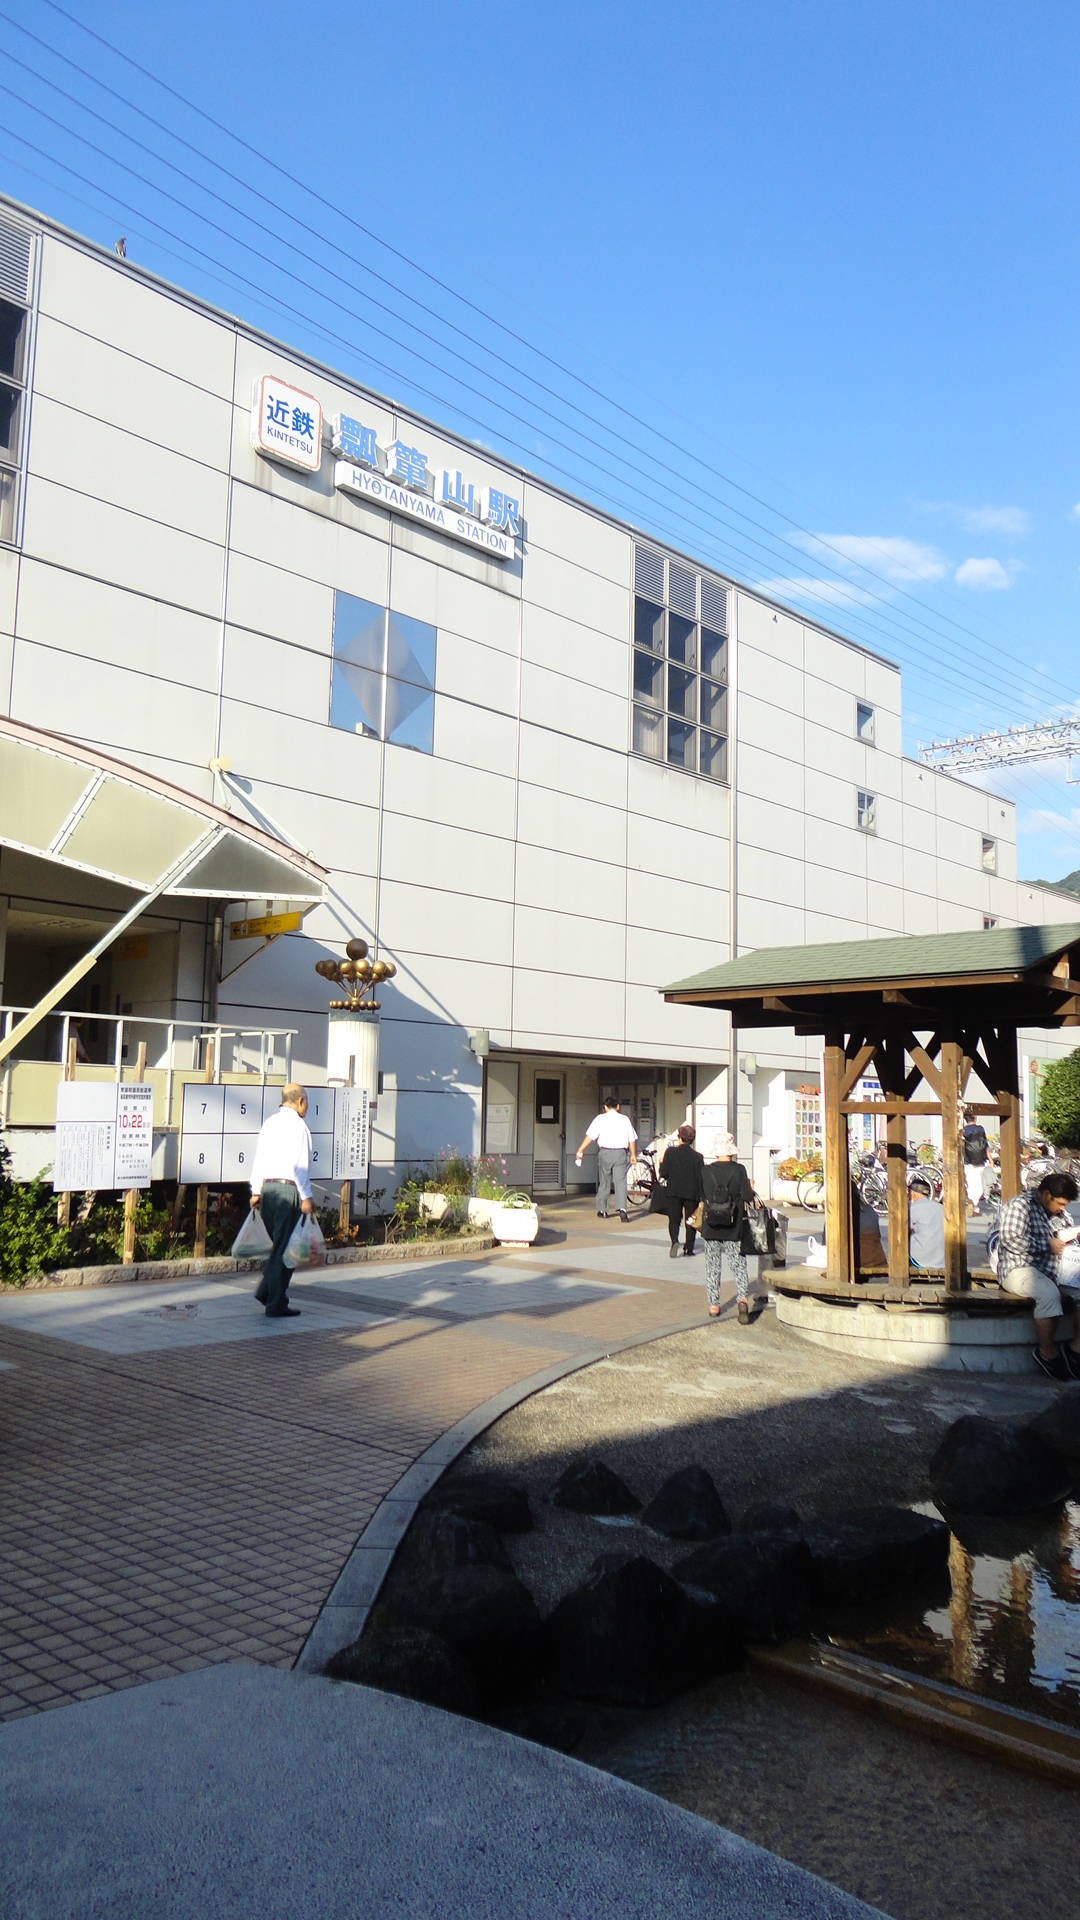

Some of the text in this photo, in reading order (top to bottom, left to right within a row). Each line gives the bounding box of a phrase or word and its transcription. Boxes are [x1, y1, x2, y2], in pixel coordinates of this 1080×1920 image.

[266, 395, 315, 440] 近鉄
[266, 425, 313, 455] KINTETSU
[456, 518, 507, 552] STATION
[201, 1103, 207, 1114] 7
[240, 1103, 246, 1114] 5
[315, 1105, 319, 1115] 1
[198, 1153, 205, 1164] 8
[238, 1152, 244, 1163] 6
[312, 1151, 318, 1161] 2
